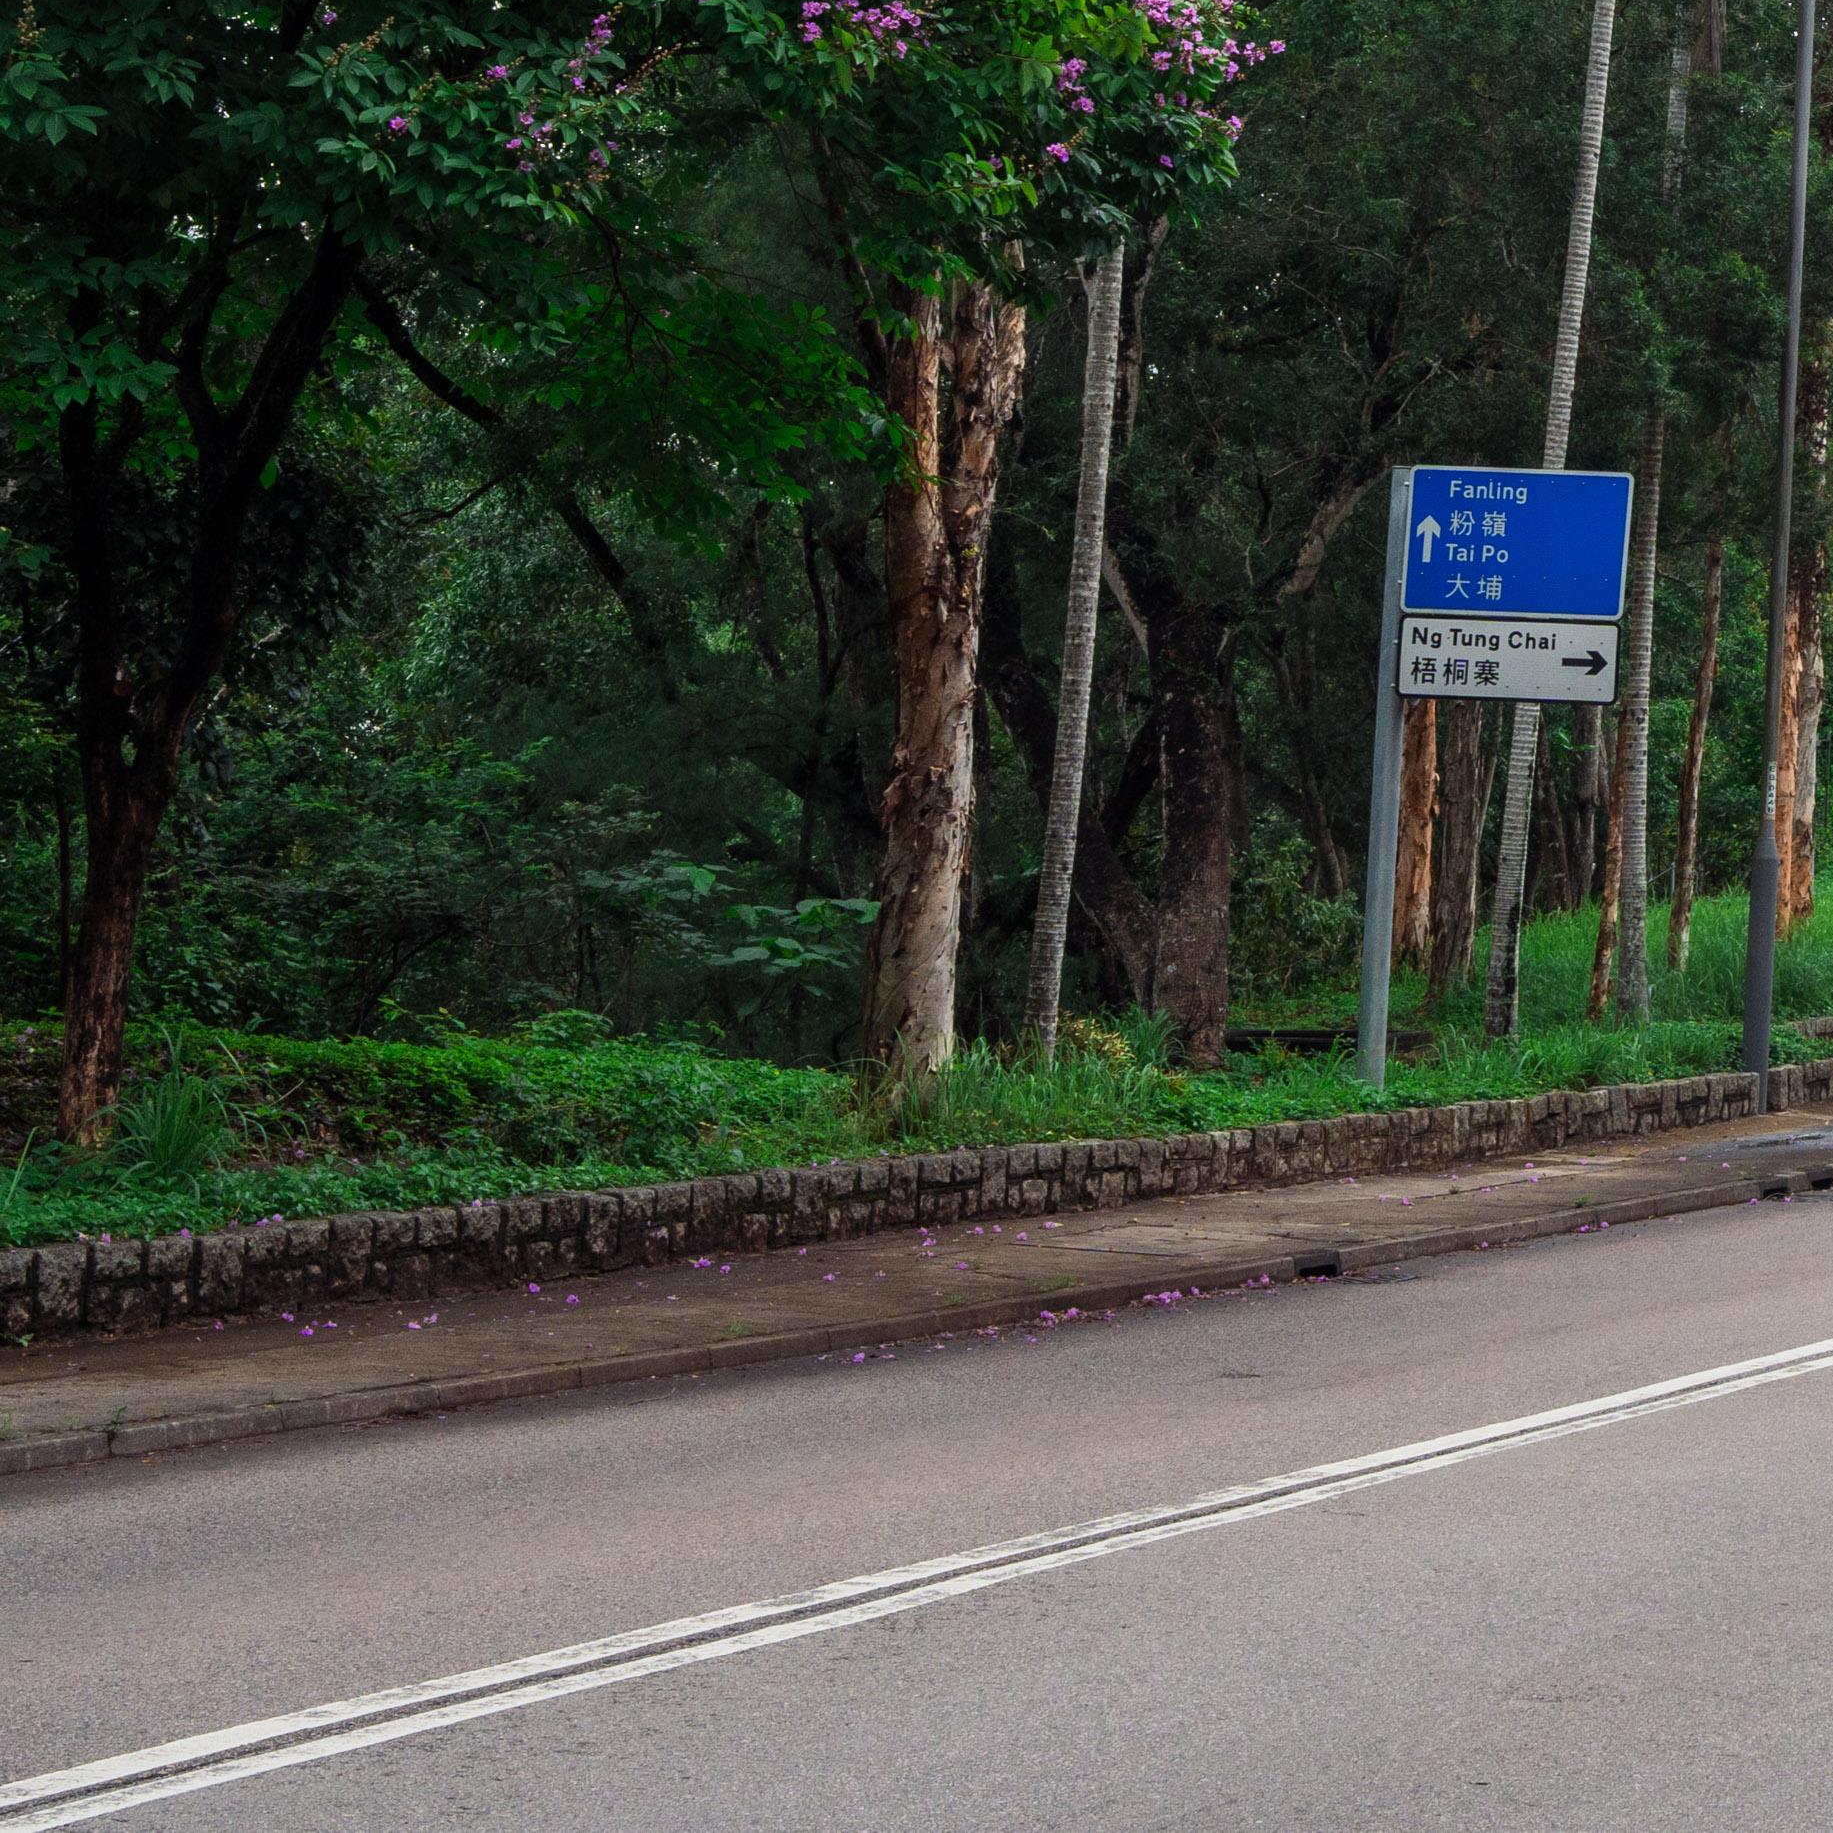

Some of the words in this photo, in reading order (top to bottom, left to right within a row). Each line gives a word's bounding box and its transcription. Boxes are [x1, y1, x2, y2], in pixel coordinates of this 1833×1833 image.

[1449, 480, 1528, 505] Fanling
[1449, 509, 1507, 537] 粉嶺
[1445, 543, 1475, 562] Tai
[1481, 544, 1509, 563] Po
[1444, 573, 1503, 601] 大埔
[1411, 626, 1442, 648] Ng
[1450, 628, 1500, 651] Tung
[1508, 631, 1556, 650] Chai
[1410, 656, 1500, 686] 梧桐寨
